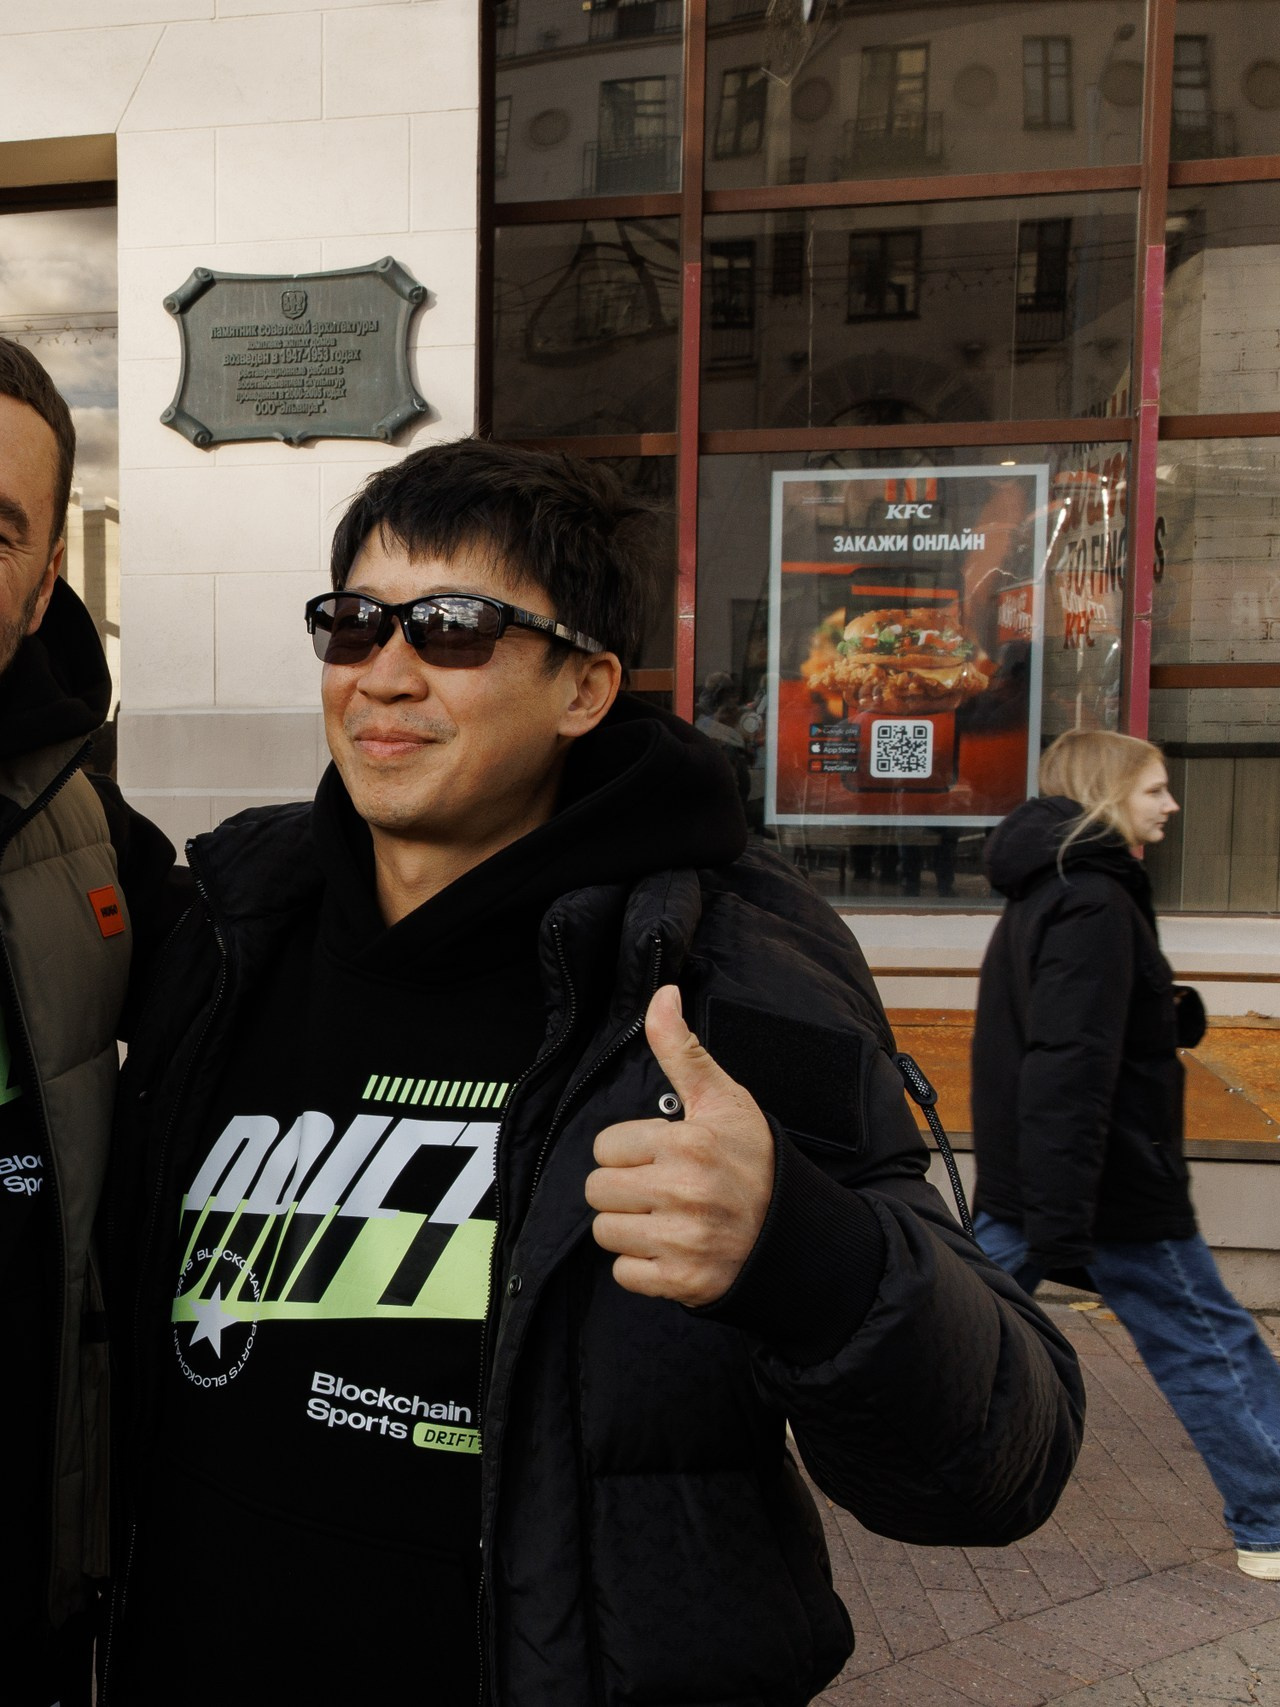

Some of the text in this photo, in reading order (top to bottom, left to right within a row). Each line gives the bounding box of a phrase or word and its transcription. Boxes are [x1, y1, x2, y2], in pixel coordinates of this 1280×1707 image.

[260, 320, 311, 336] советской
[312, 320, 379, 337] архитектуры
[271, 353, 279, 364] в
[280, 348, 330, 363] 1947-1953
[331, 349, 361, 362] годах
[885, 503, 933, 520] KFC
[833, 528, 986, 552] ЗАКАЖИ ОНЛАЙН
[311, 1371, 472, 1423] Blockchain
[307, 1398, 478, 1448] Sports DRIFT
